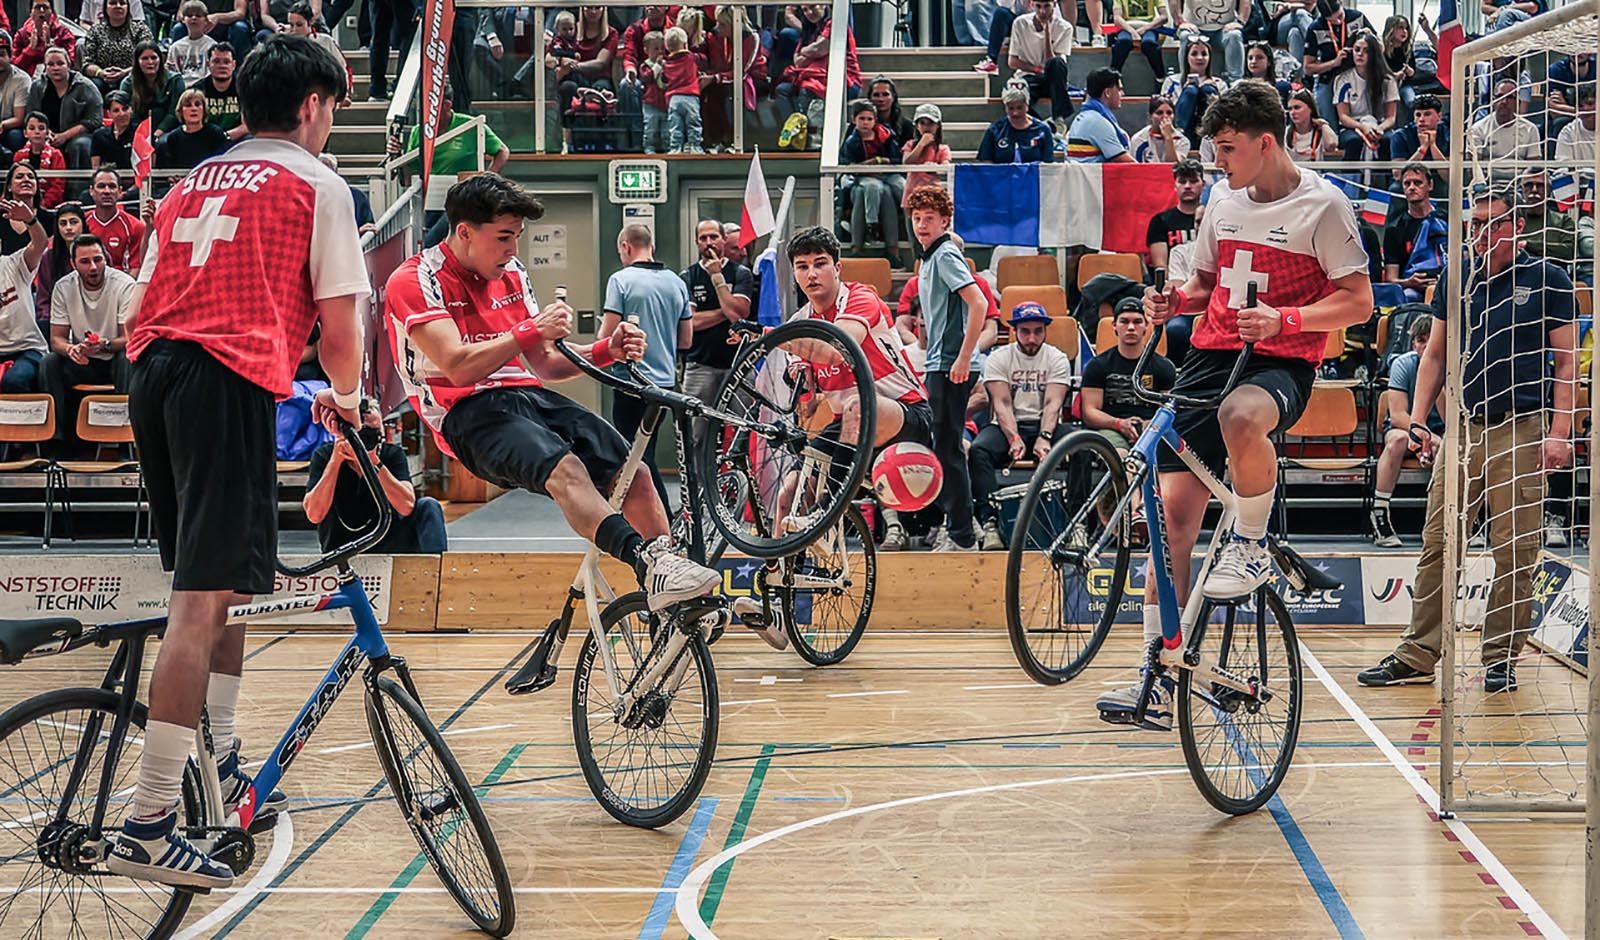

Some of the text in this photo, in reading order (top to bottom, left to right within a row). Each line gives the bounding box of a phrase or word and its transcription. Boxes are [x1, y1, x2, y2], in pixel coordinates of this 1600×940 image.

[426, 0, 443, 62] Brunn
[182, 164, 279, 195] SUISSE
[36, 593, 119, 610] TECHNIK
[233, 598, 316, 617] DURATEC
[577, 638, 599, 706] EQUINO
